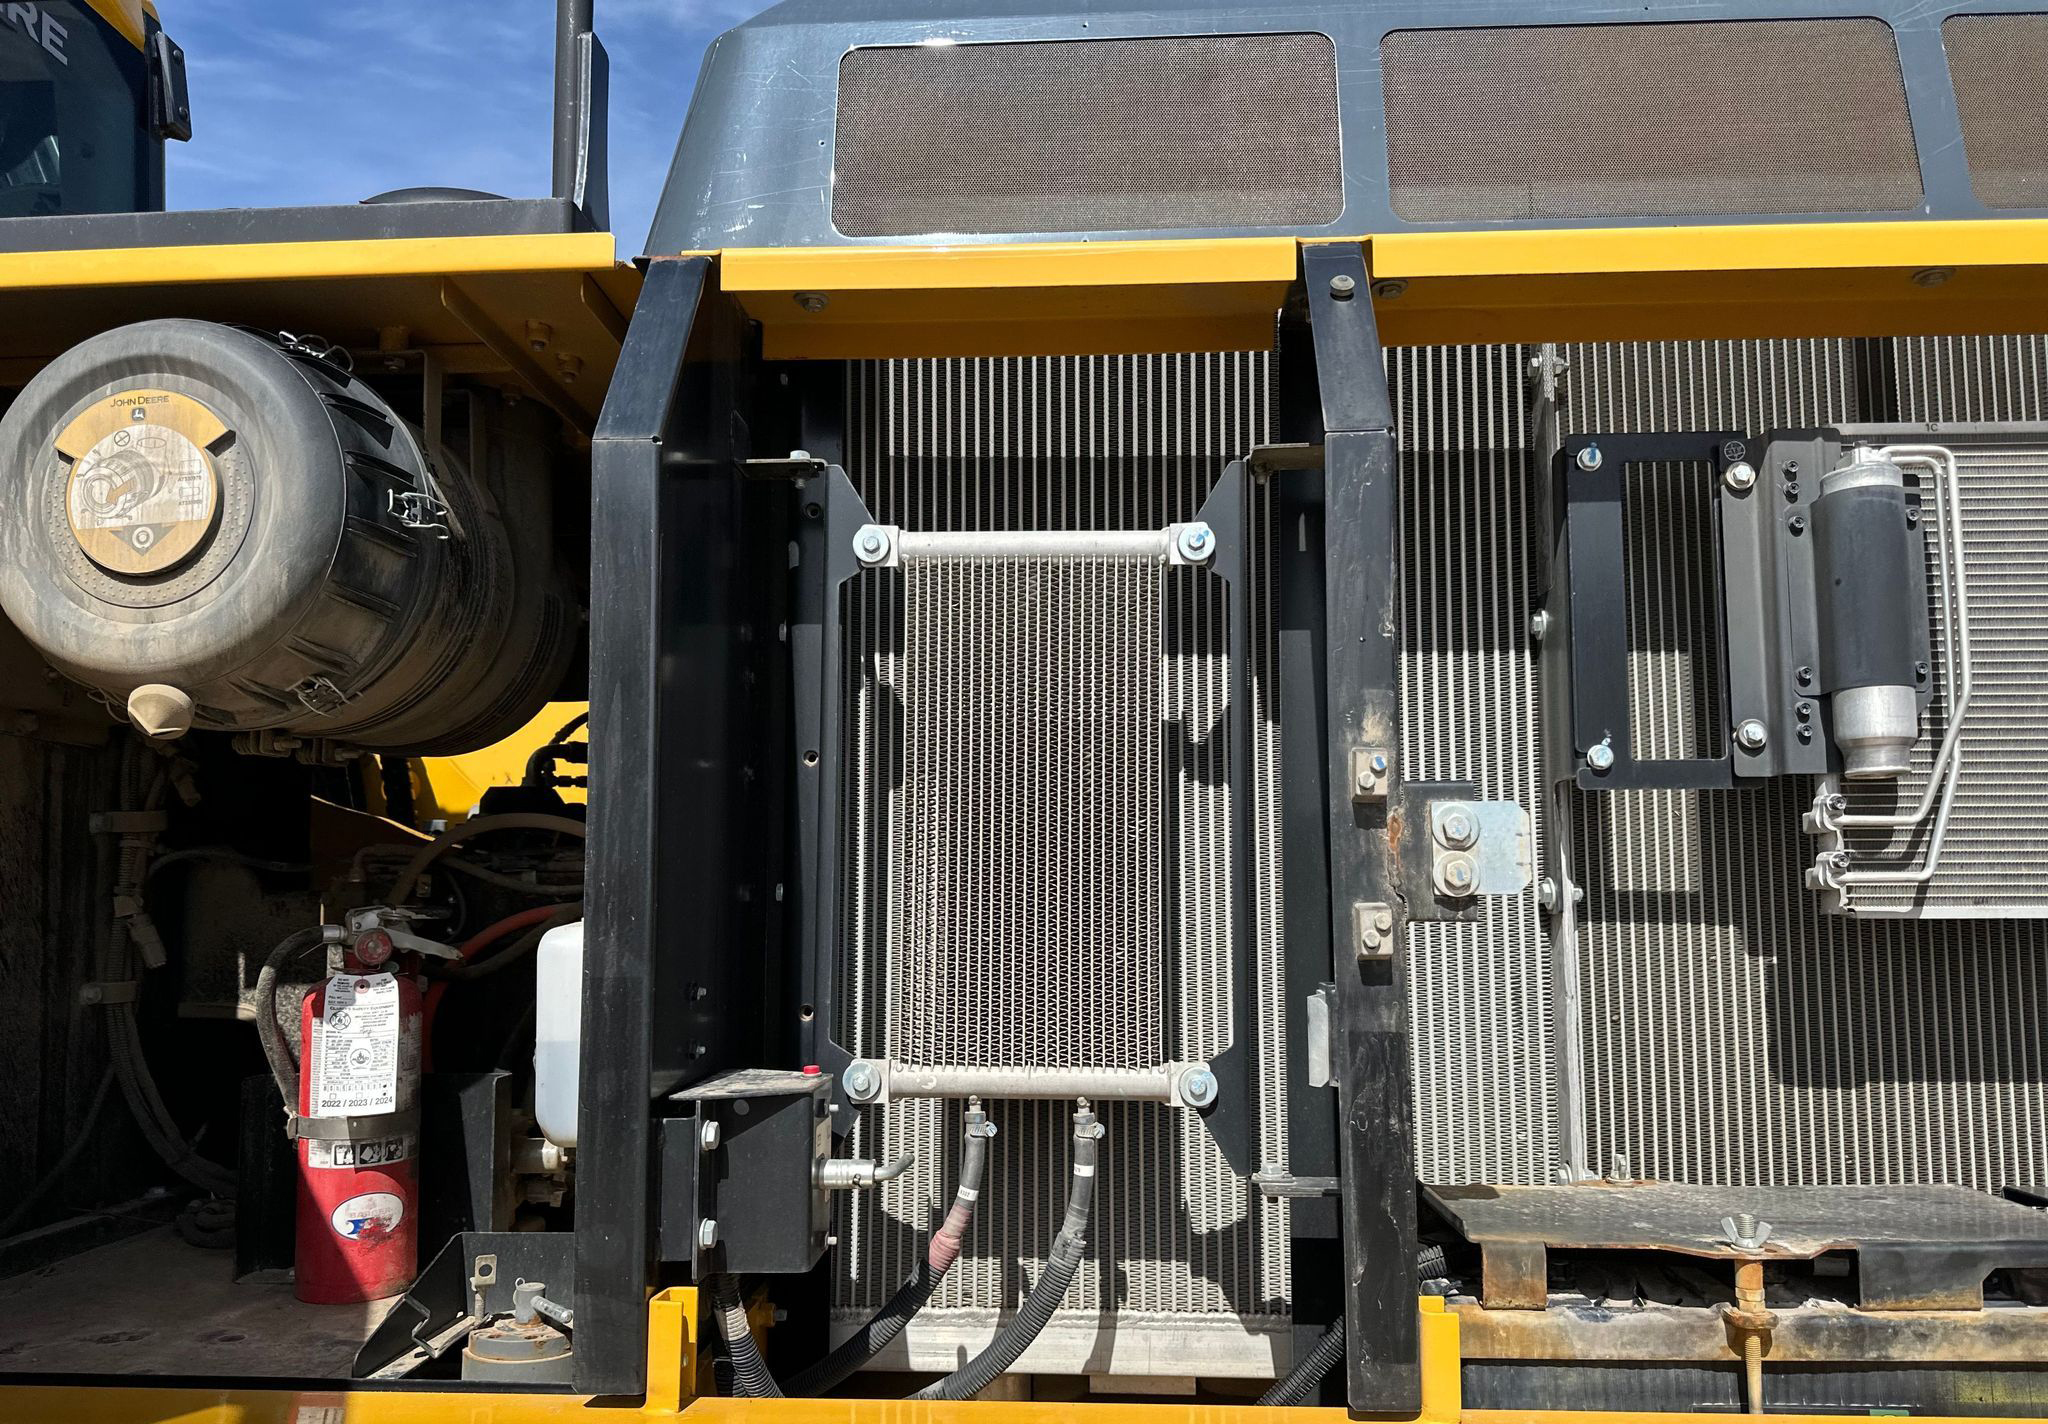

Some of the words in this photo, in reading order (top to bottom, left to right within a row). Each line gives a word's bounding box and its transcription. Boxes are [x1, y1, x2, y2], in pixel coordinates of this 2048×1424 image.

[0, 2, 68, 66] RE
[110, 398, 136, 408] JOHN
[137, 395, 169, 404] DEERE
[321, 1099, 341, 1108] 2022
[342, 1099, 347, 1108] /
[348, 1098, 368, 1107] 2023
[375, 1096, 393, 1105] 2024
